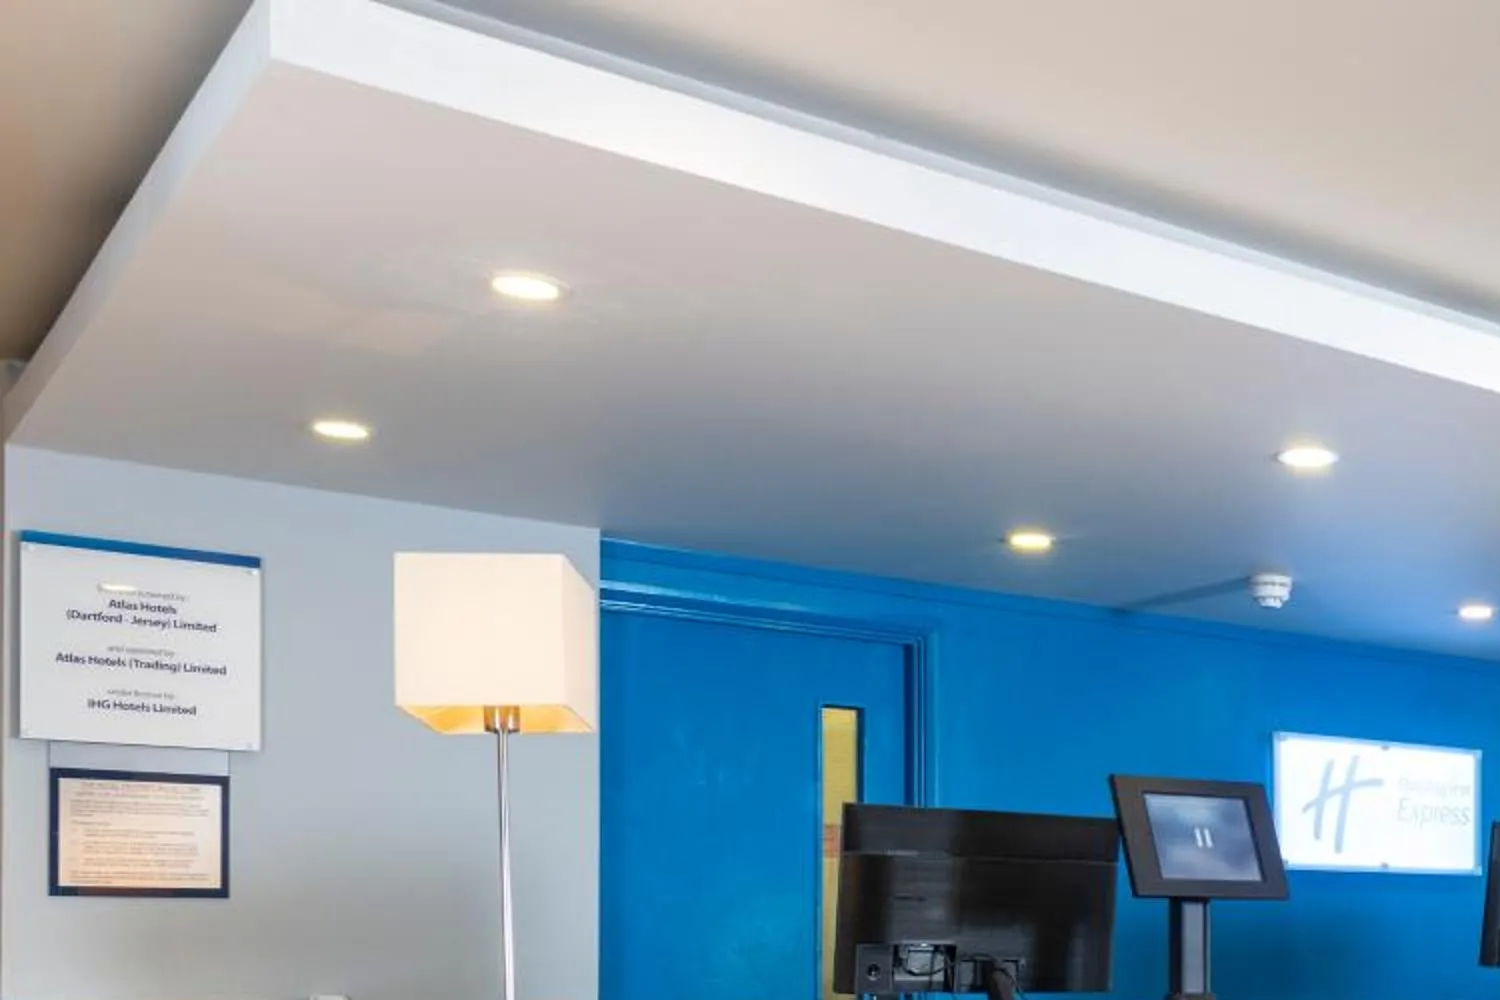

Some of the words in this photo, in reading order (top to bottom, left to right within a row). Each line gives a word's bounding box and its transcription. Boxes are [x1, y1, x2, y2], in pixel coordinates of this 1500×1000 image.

[108, 598, 139, 611] Atlas
[140, 602, 177, 615] Hotels
[66, 609, 123, 624] (Dartford
[131, 615, 171, 631] Jersey)
[173, 619, 217, 633] Limited
[56, 651, 86, 665] Atlas
[88, 655, 127, 668] Hotels
[129, 658, 181, 674] (Trading)
[183, 662, 227, 676] Limited
[87, 698, 111, 710] IHG
[113, 701, 151, 713] Hotels
[153, 703, 197, 716] Limited
[1396, 797, 1471, 831] Express
